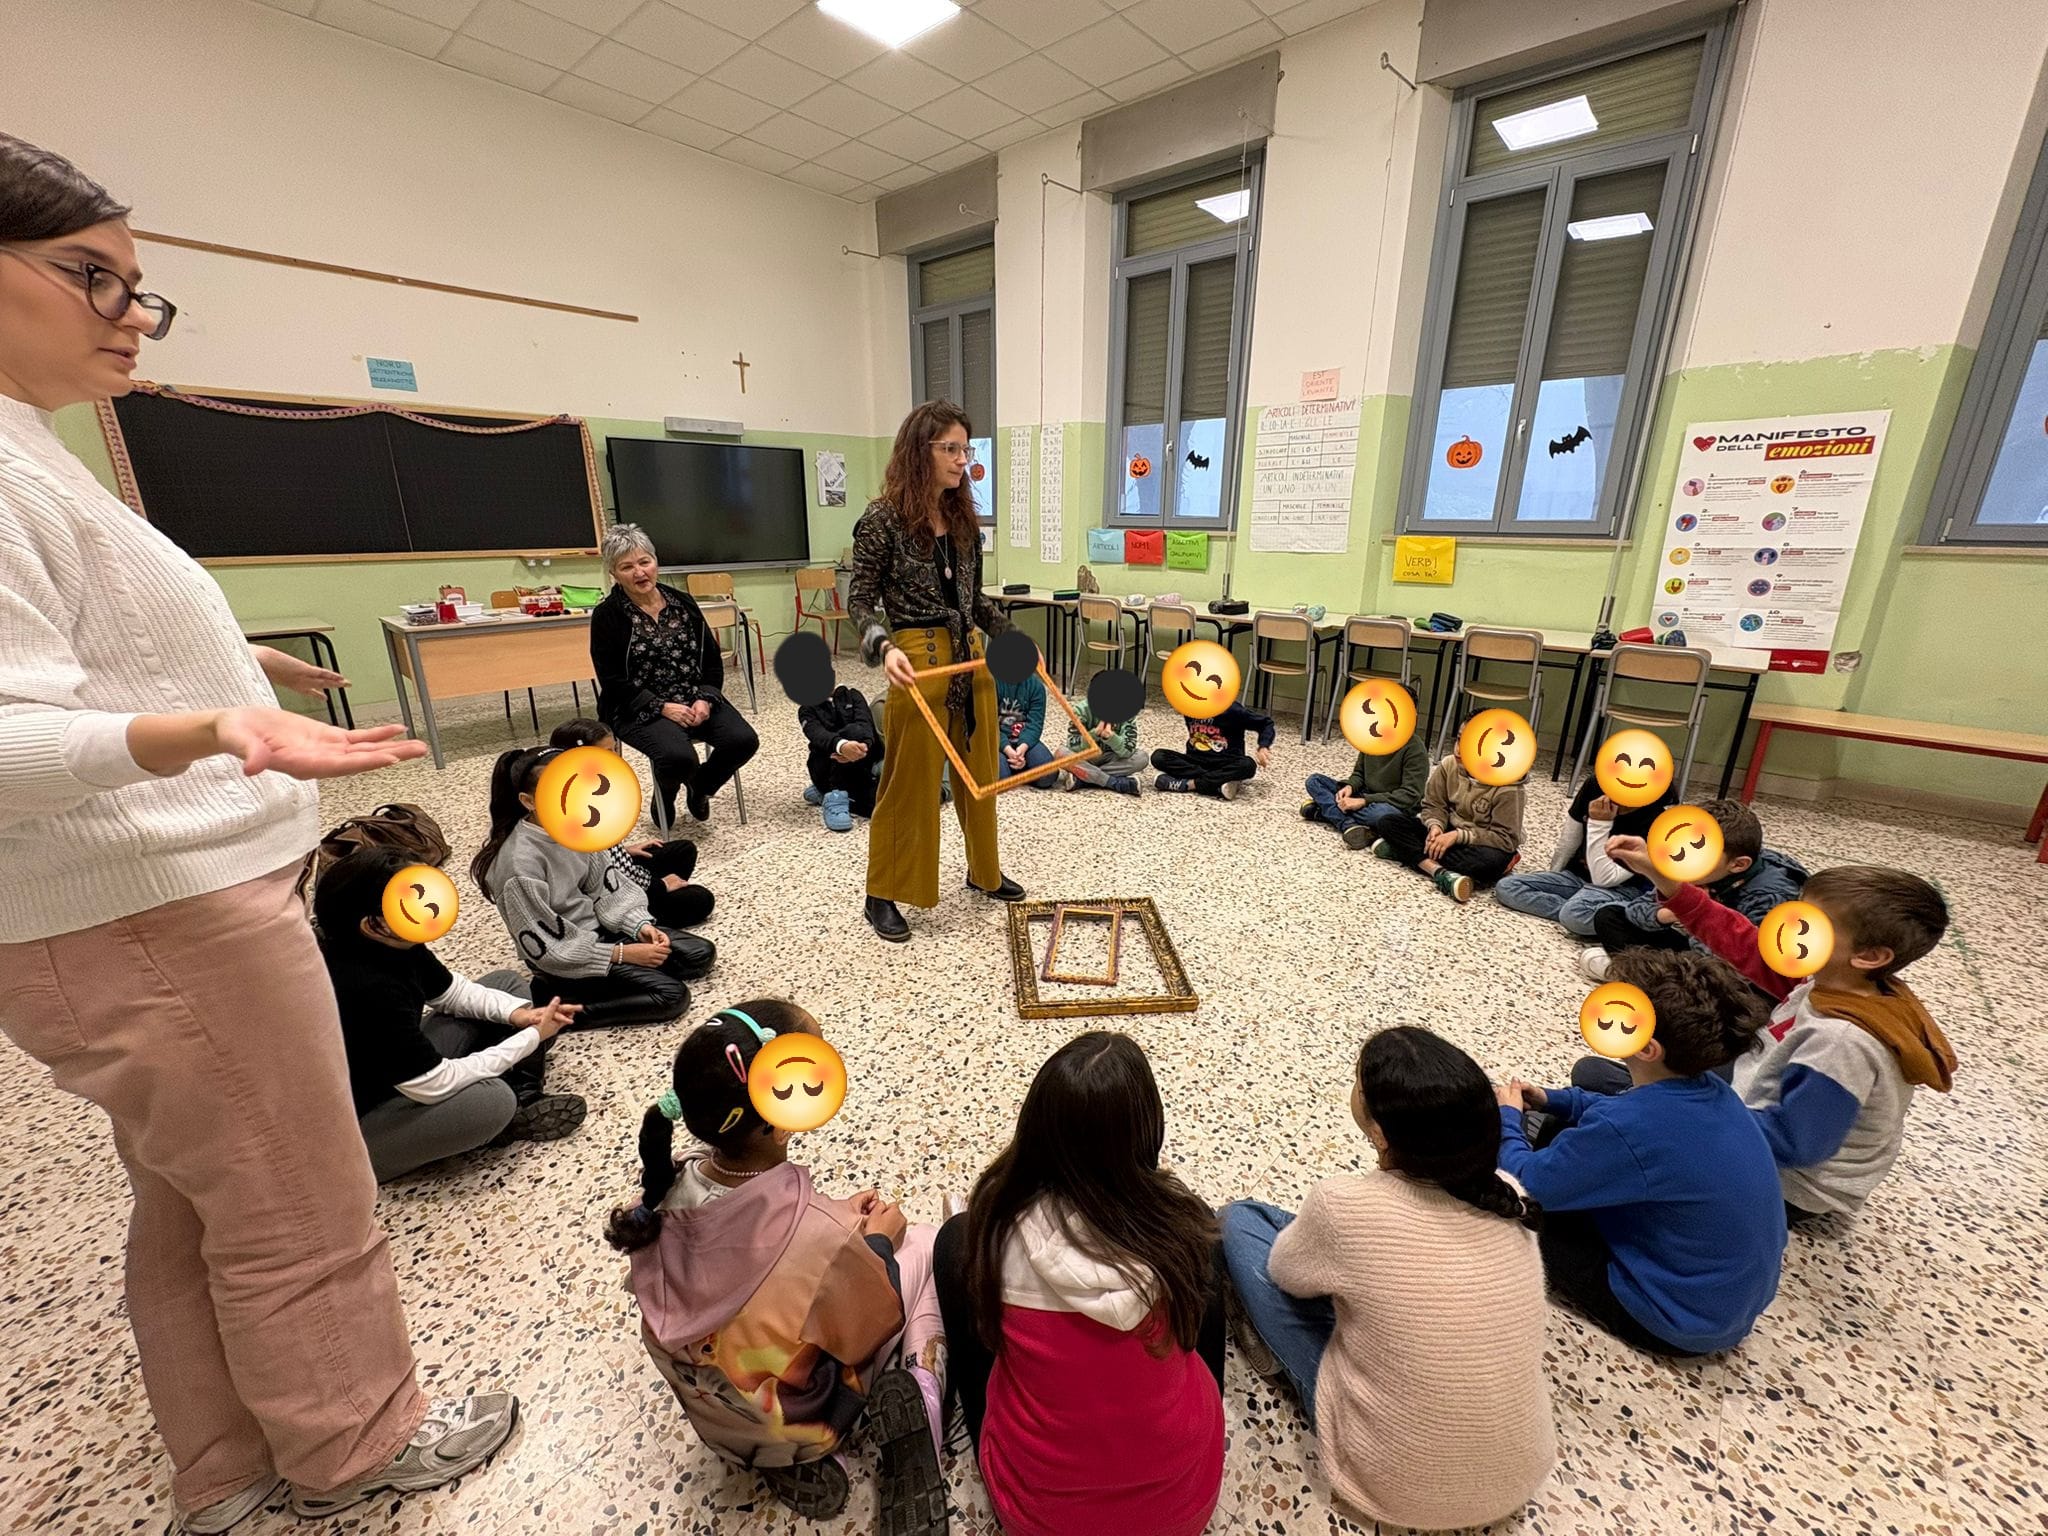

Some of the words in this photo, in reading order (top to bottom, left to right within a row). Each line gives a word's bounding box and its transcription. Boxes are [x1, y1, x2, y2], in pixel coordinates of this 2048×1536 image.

[1313, 371, 1325, 380] EST
[1718, 426, 1867, 444] MANIFESTO
[1716, 443, 1764, 452] DELLE
[1768, 437, 1872, 459] emozioni
[1092, 542, 1120, 551] ARTICOLI
[1405, 553, 1438, 569] VERBI
